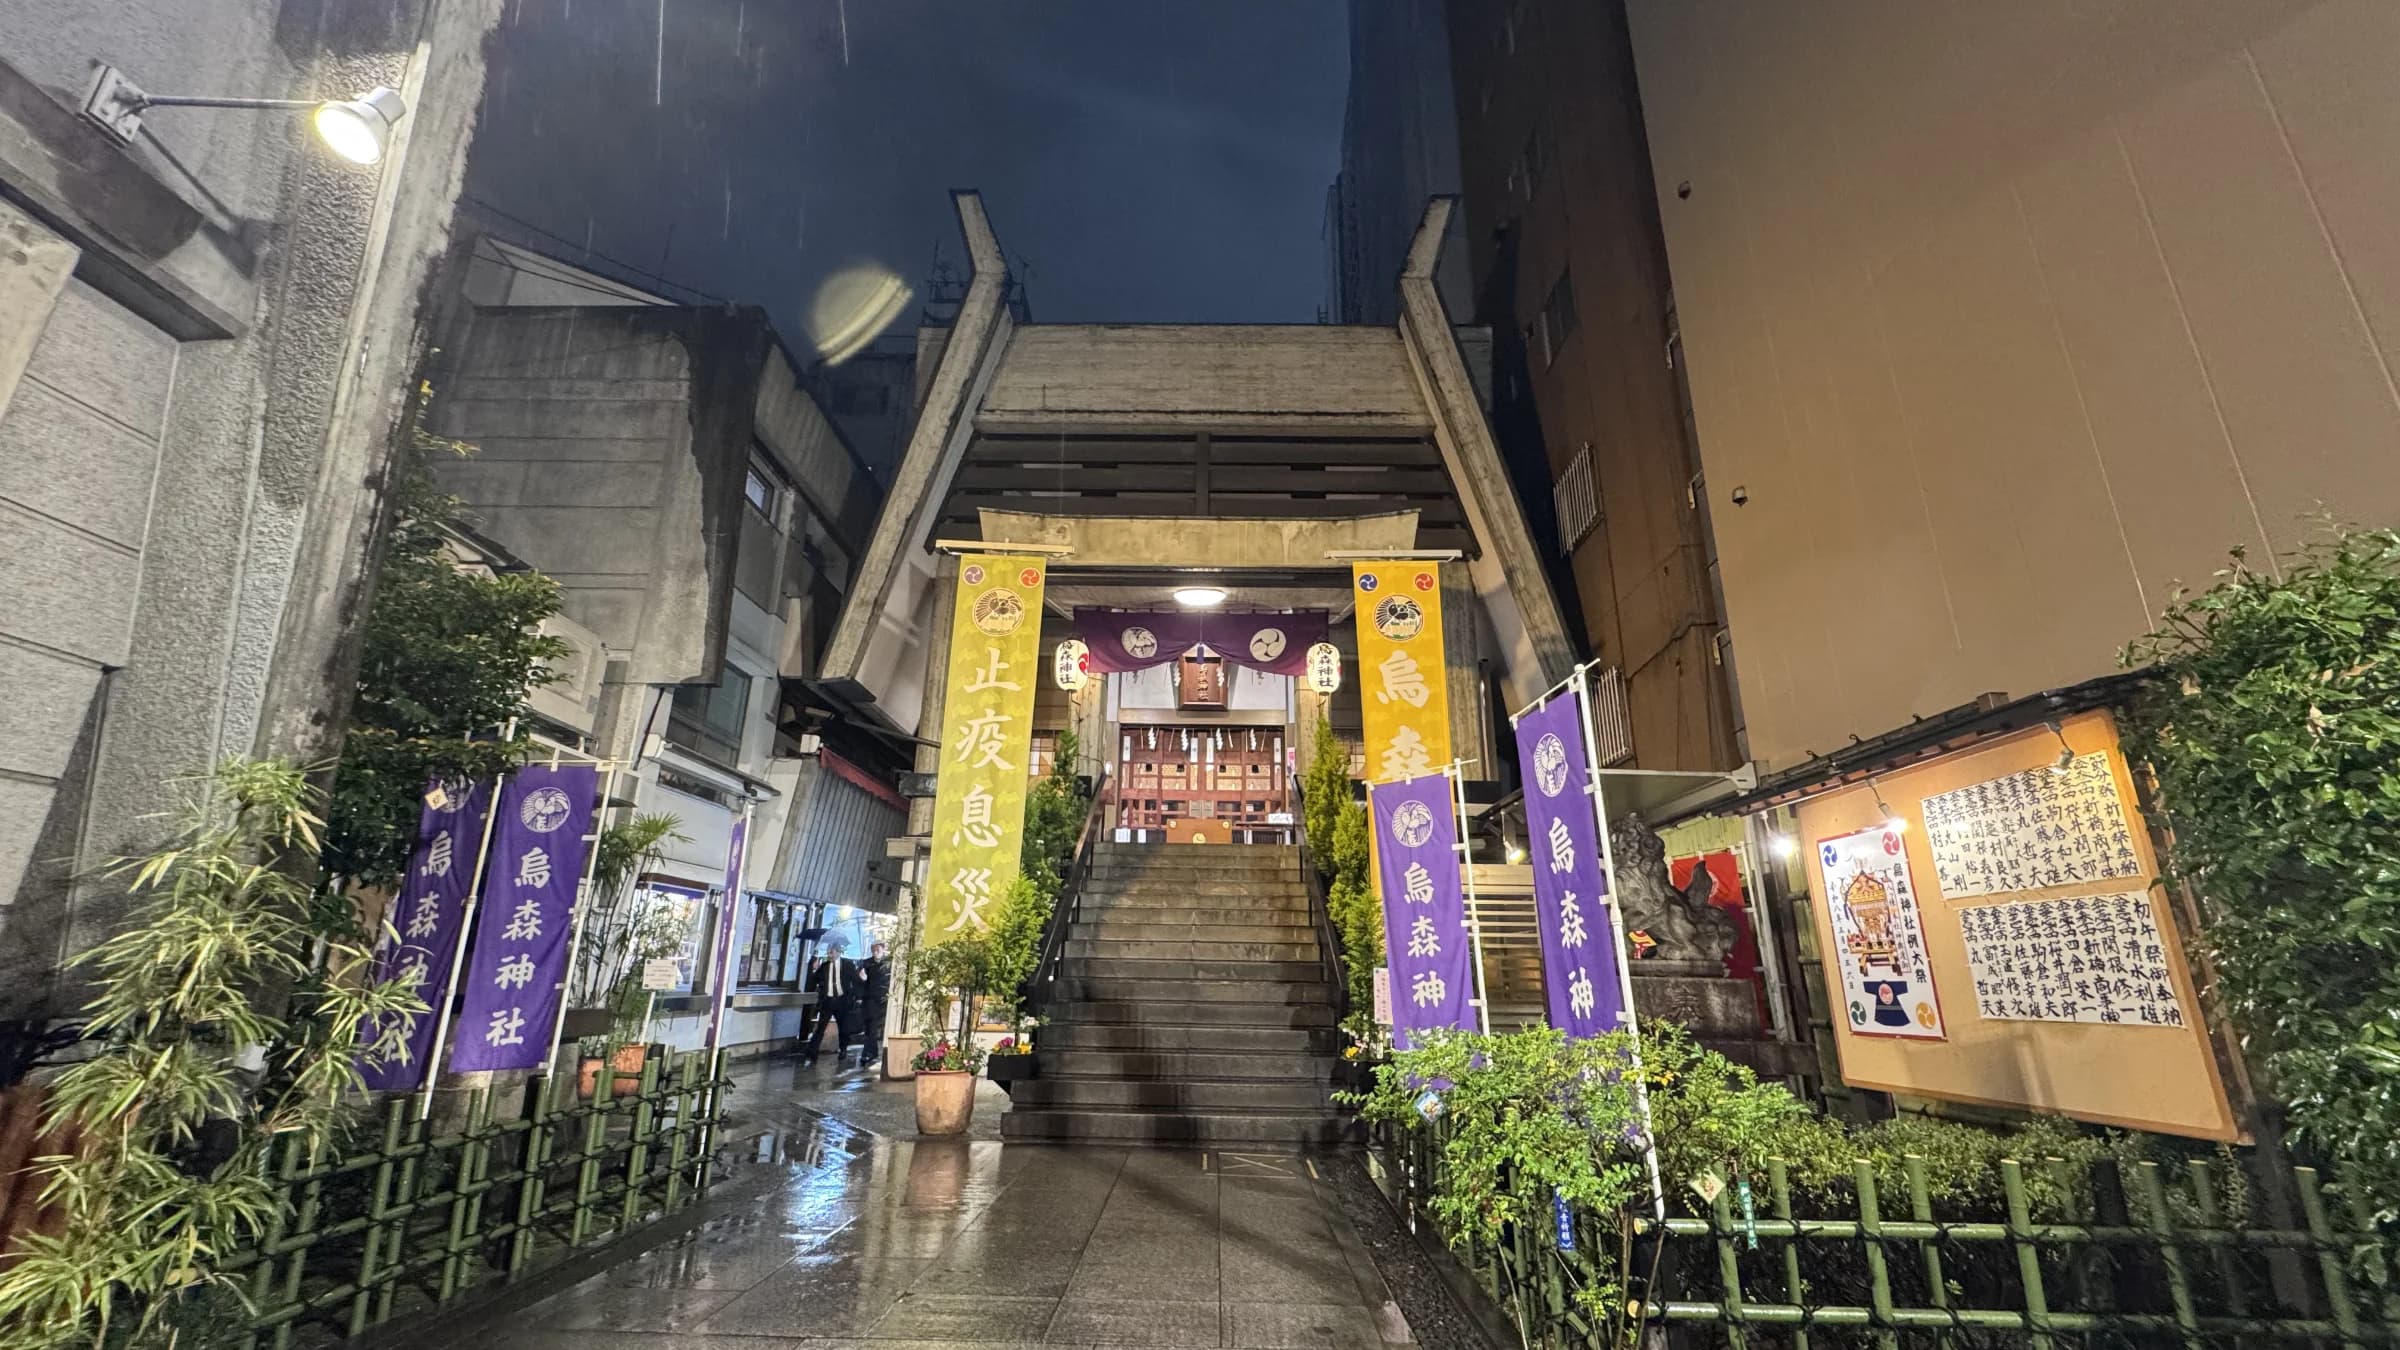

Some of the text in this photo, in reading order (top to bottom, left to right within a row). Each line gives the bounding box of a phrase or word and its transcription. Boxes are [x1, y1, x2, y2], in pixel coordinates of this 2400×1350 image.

[1316, 644, 1334, 688] 烏森神社
[945, 647, 1022, 933] 止疫息災
[486, 846, 551, 1047] 烏森神社
[1404, 862, 1446, 1041] 烏森神
[1548, 816, 1602, 1060] 烏森神
[2134, 898, 2181, 1024] 初午祭御奉納
